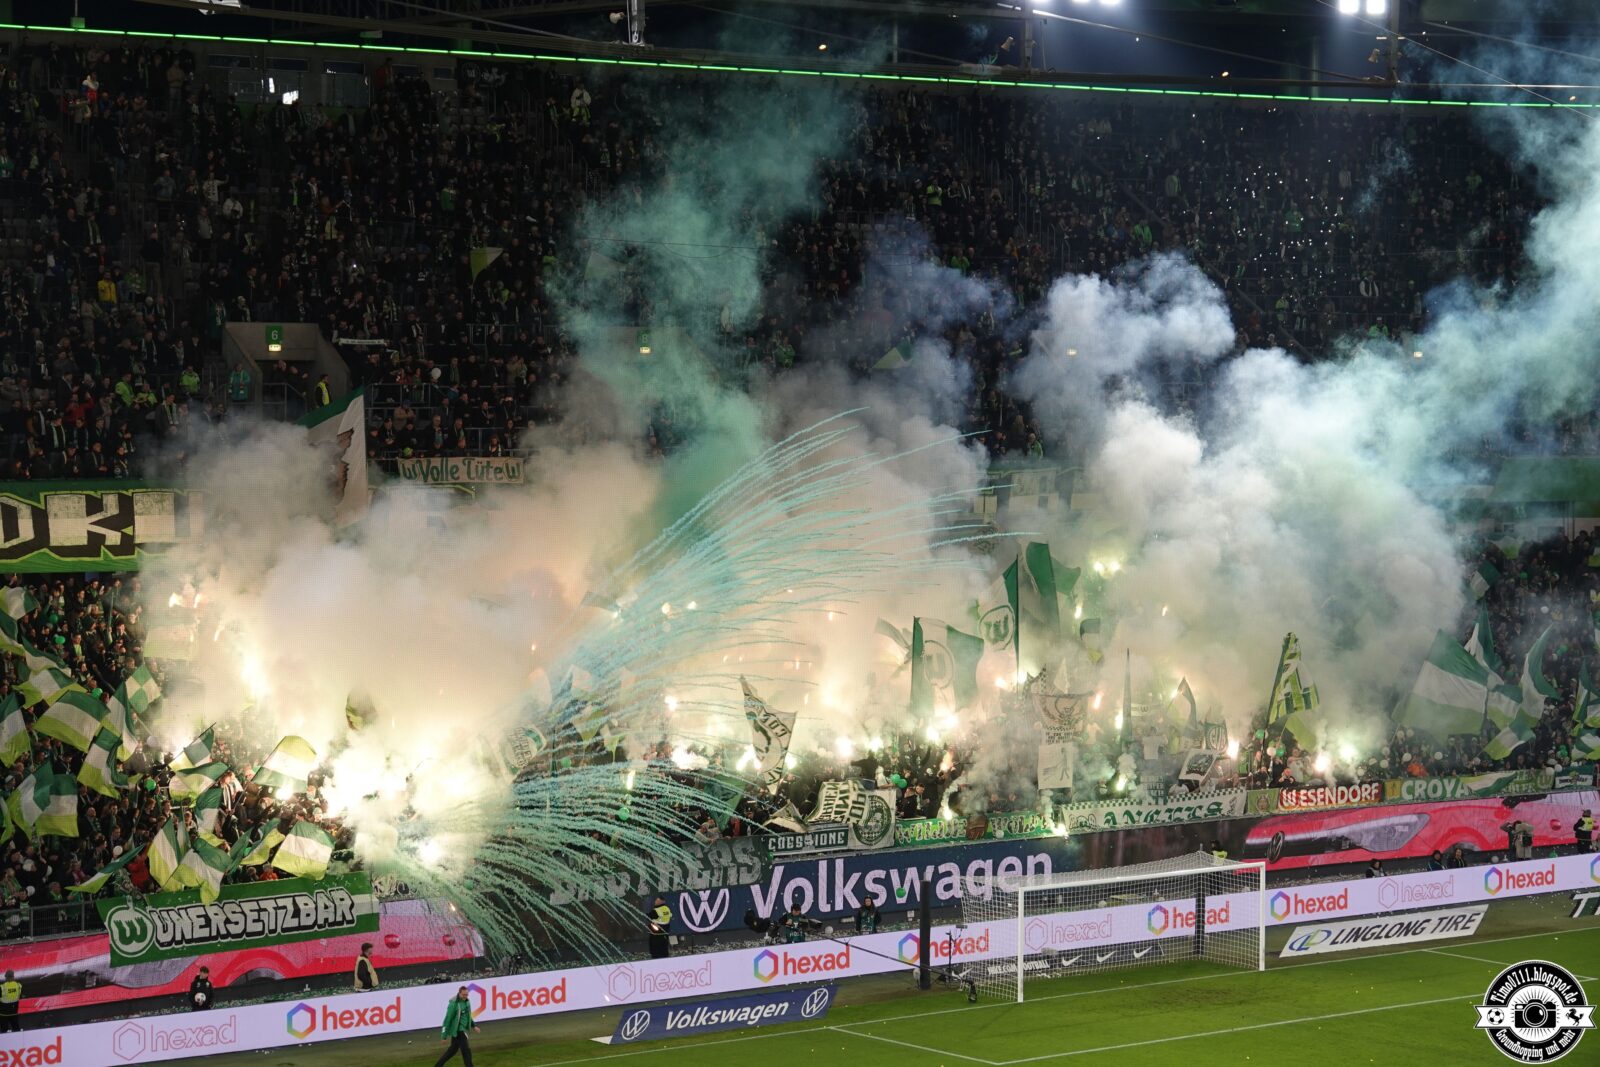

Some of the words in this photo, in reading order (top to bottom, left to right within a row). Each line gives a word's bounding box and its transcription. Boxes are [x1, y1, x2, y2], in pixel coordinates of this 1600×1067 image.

[271, 329, 279, 341] 6
[417, 457, 459, 482] Volle
[463, 457, 503, 481] Tüte
[1281, 782, 1379, 808] WESENDORF
[751, 851, 1053, 919] Volkswagen
[1401, 875, 1454, 903] hexad
[1505, 864, 1555, 889] hexad
[1172, 900, 1229, 928] head
[1294, 888, 1348, 915] hexad
[150, 888, 355, 950] UNERSETZBAR
[1330, 924, 1430, 947] LINGLONG
[1431, 912, 1482, 935] TIRE
[783, 942, 850, 975] hexad
[640, 960, 711, 993] hexad
[492, 977, 567, 1011] hexad
[322, 996, 401, 1031] hexad
[665, 1001, 789, 1031] Volkswagen
[151, 1015, 237, 1052] hexad
[0, 1036, 62, 1067] exad
